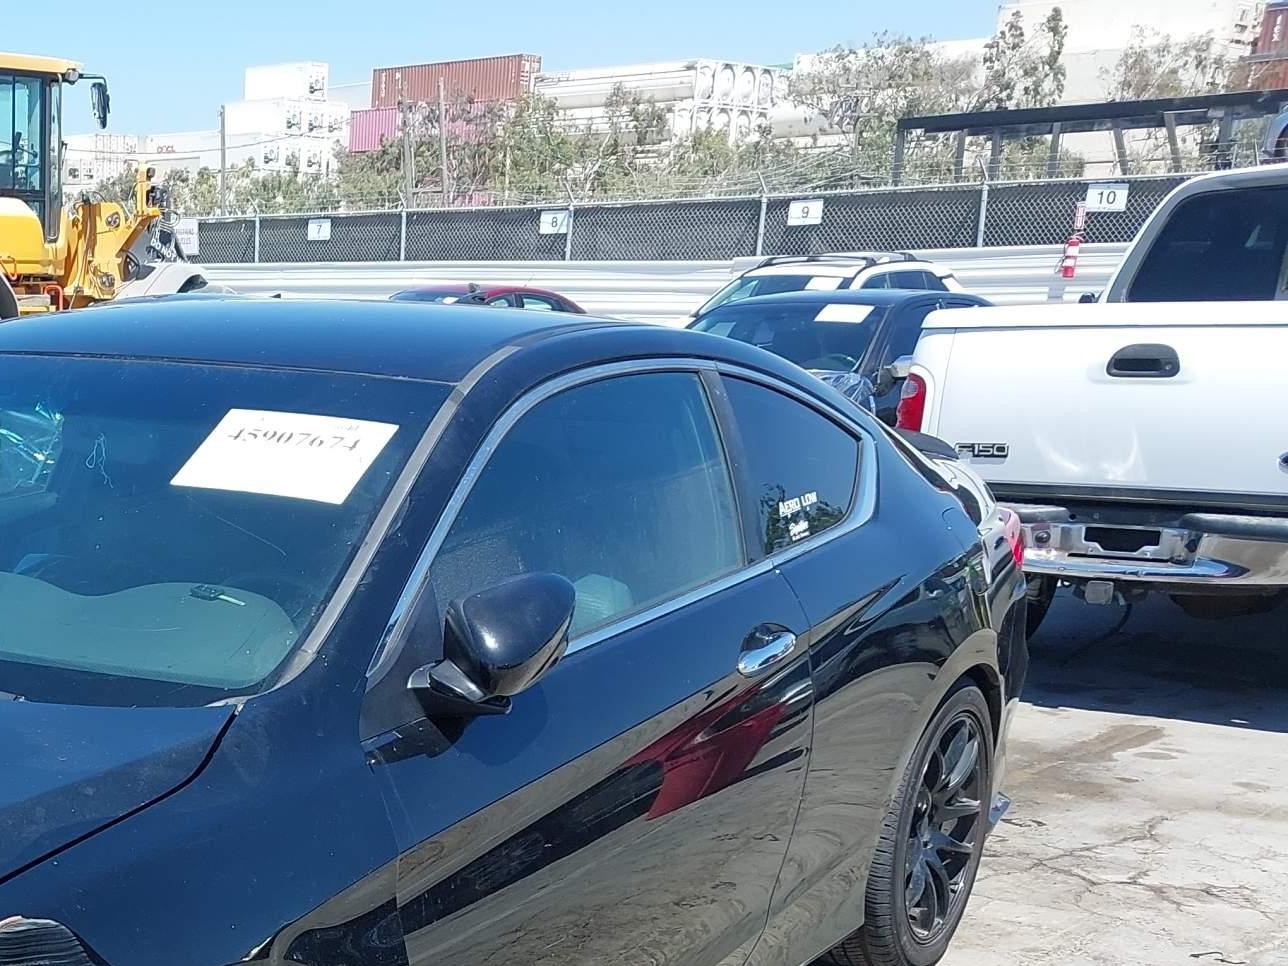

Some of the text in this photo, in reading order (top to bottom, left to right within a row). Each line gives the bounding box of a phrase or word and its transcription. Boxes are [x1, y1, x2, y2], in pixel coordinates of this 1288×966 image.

[1097, 190, 1117, 205] 10
[802, 206, 809, 218] 9
[552, 216, 558, 228] 8
[316, 224, 322, 235] 7
[227, 428, 361, 452] 45907674
[778, 497, 801, 518] AERO
